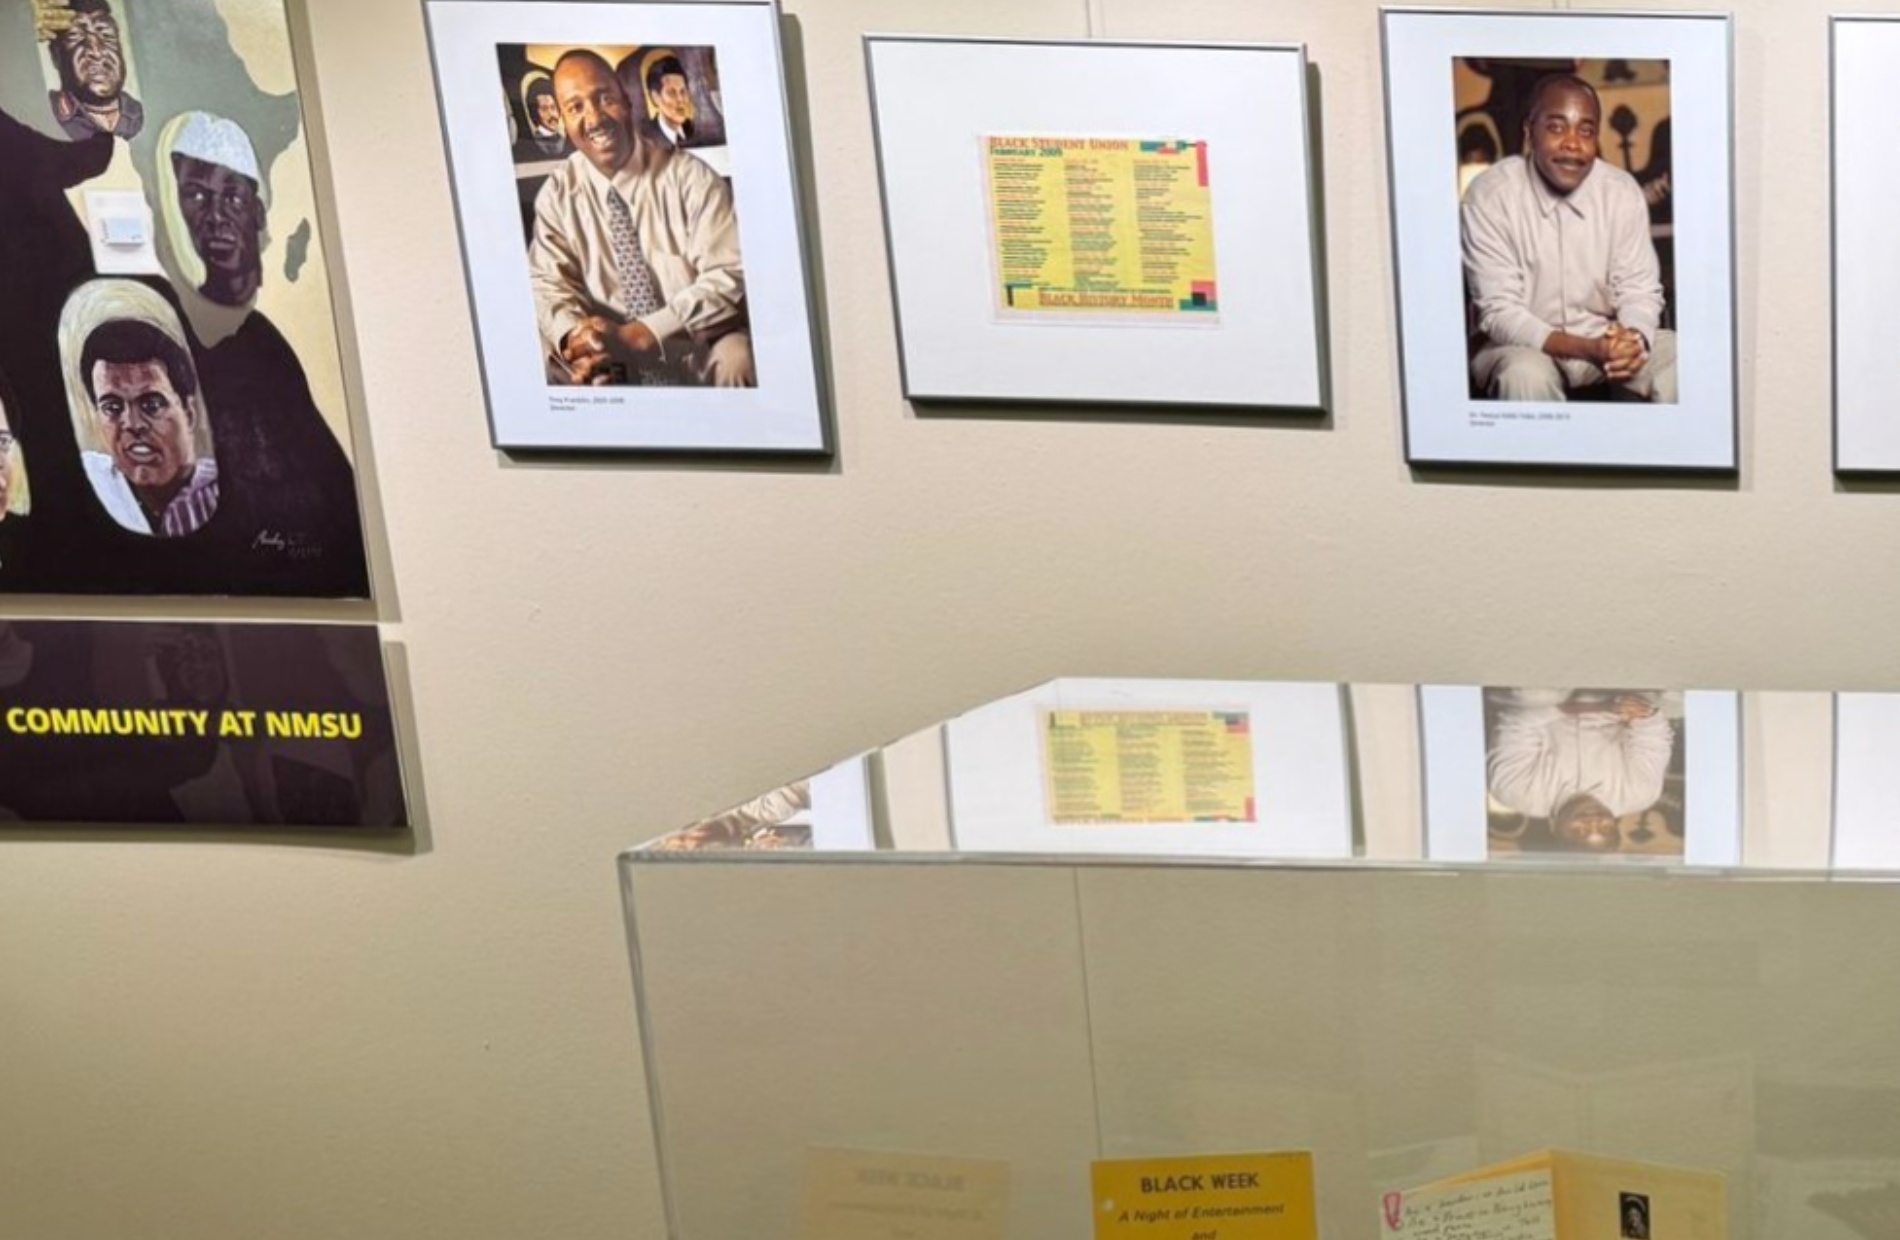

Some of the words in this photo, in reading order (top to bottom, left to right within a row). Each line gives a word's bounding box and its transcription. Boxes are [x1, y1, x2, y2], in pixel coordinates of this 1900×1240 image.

[1031, 137, 1085, 149] STUDENT
[1089, 138, 1128, 150] UNION
[6, 708, 208, 737] COMMUNITY
[219, 710, 258, 738] AT
[267, 711, 363, 740] NMSU
[1141, 1175, 1204, 1193] BLACK
[1212, 1172, 1259, 1190] WEEK
[1118, 1210, 1130, 1222] A
[1134, 1209, 1171, 1225] Night
[1174, 1207, 1188, 1220] of
[1192, 1202, 1285, 1219] Entertainment
